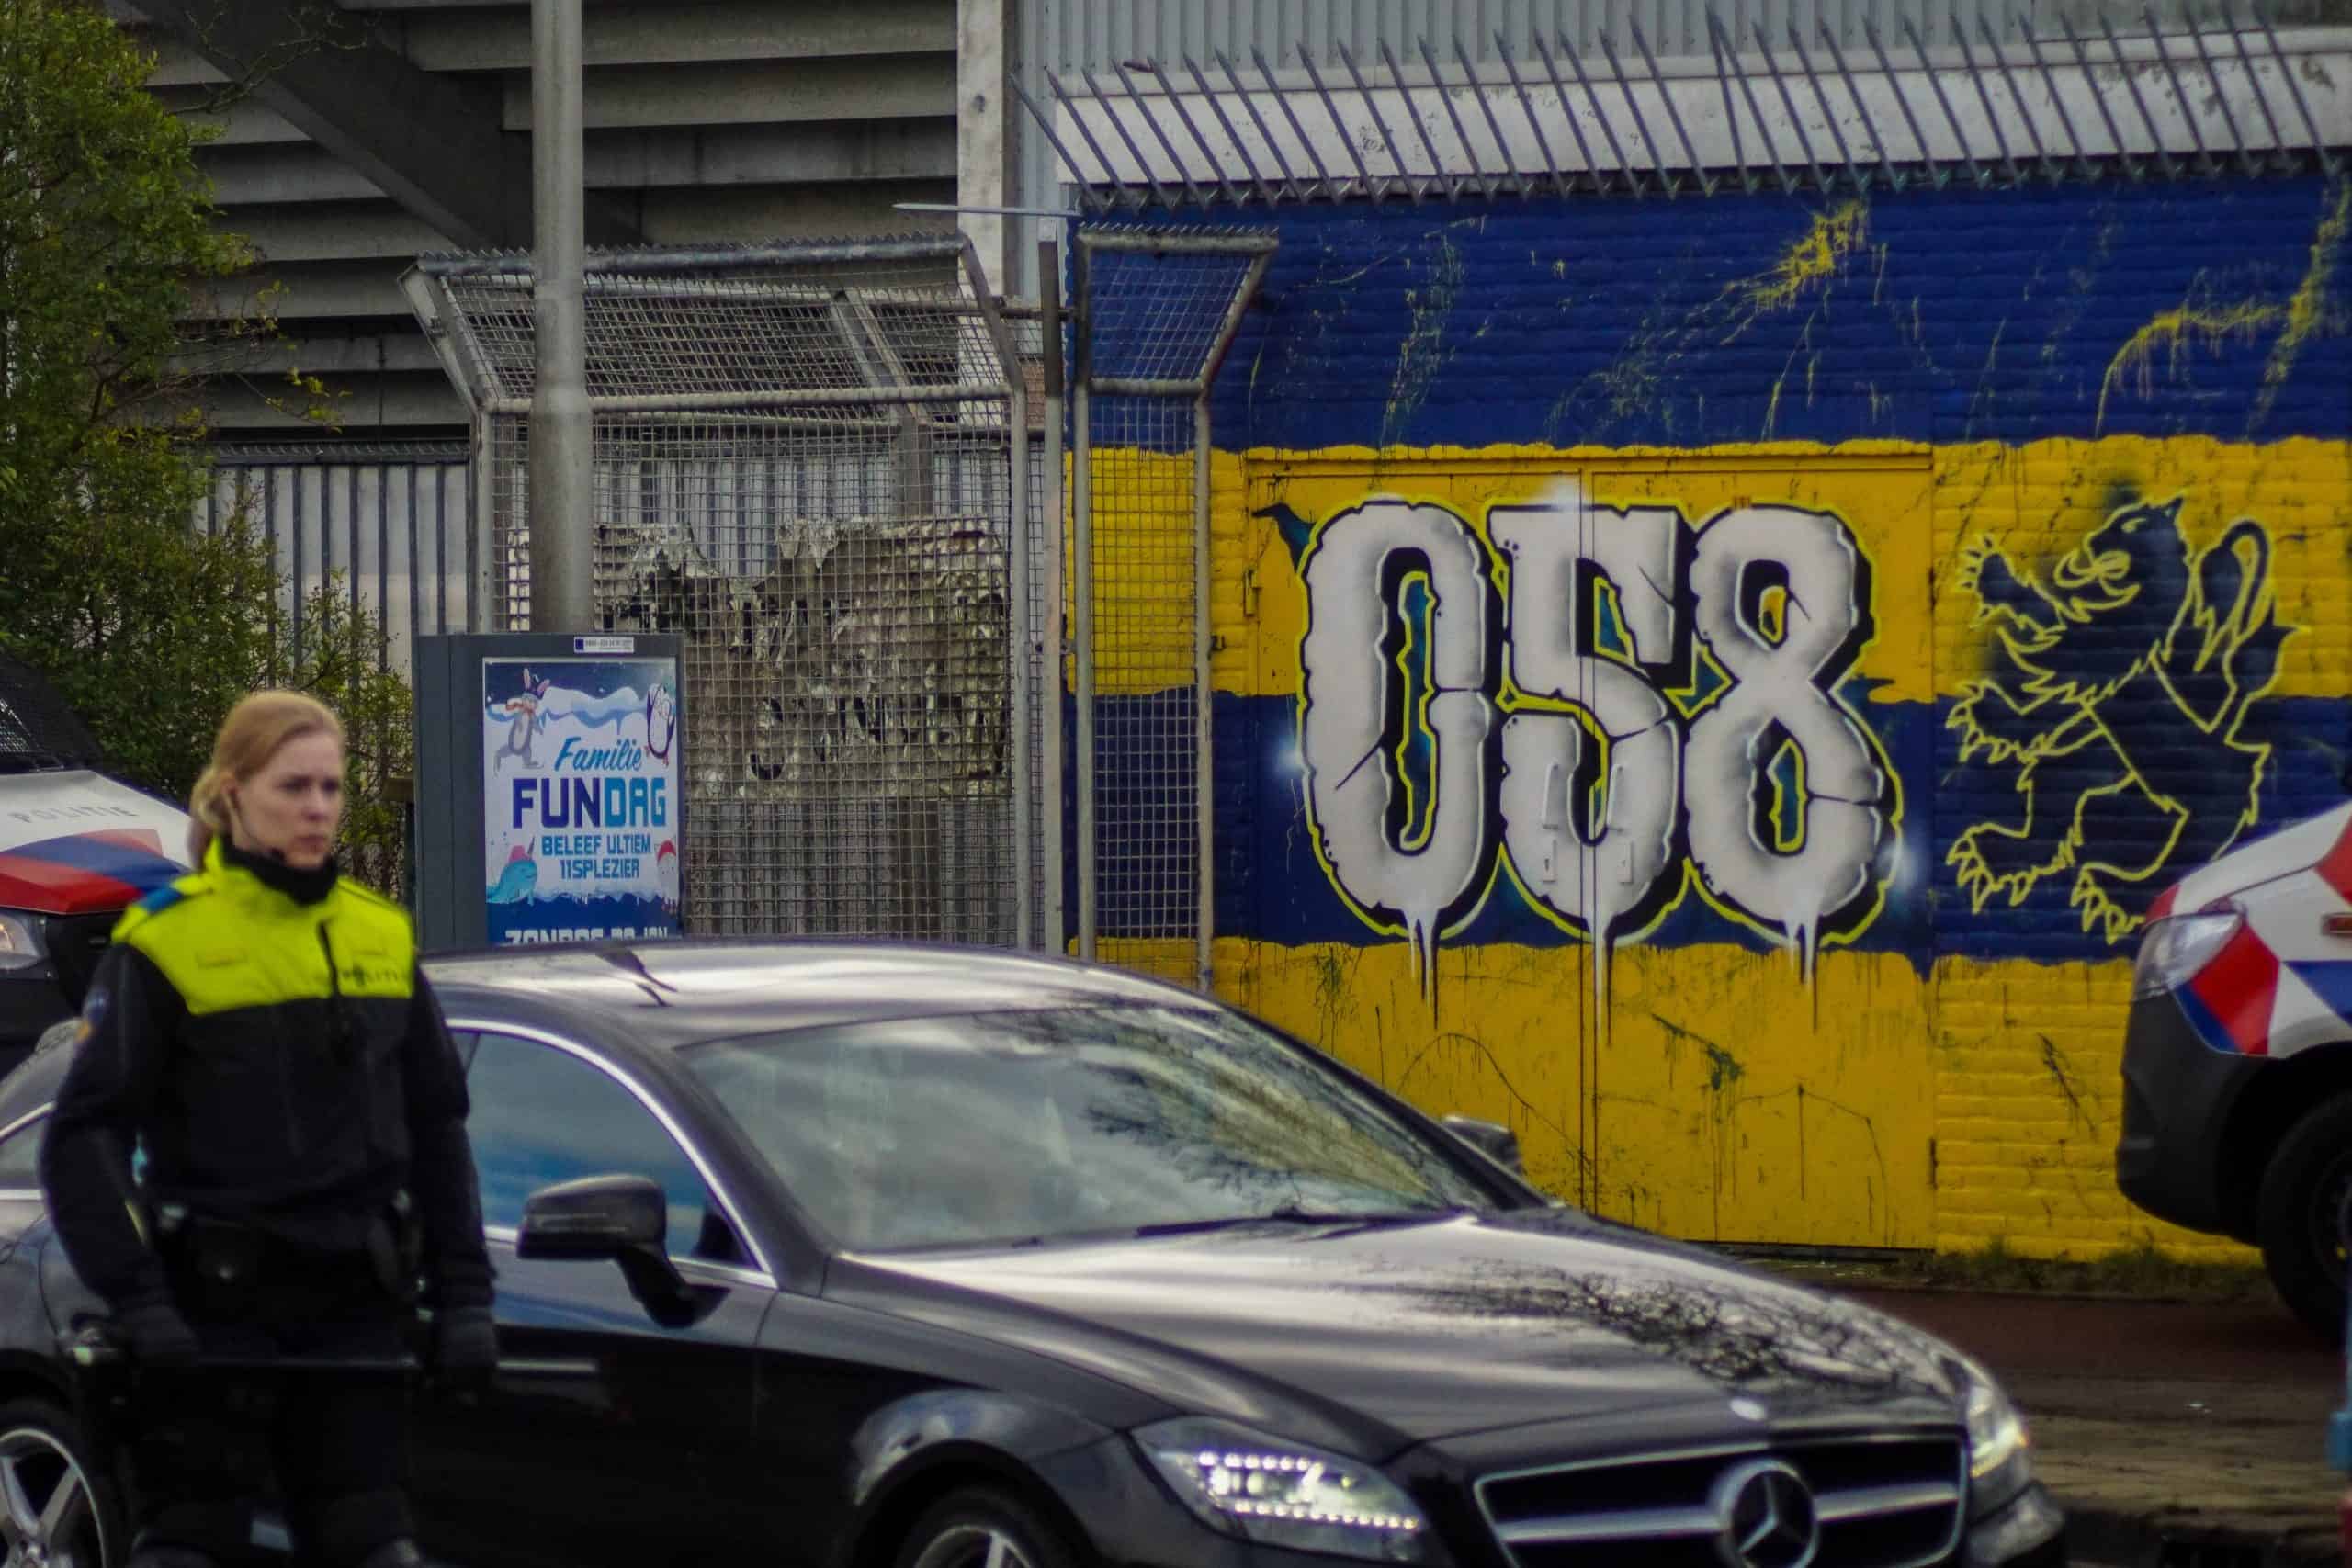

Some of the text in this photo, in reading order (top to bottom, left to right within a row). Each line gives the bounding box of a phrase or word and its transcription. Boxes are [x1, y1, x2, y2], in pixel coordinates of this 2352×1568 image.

[1297, 496, 1904, 948] 058
[554, 738, 642, 772] Familie
[513, 778, 666, 829] FUNDAG
[541, 833, 651, 855] BELEEF ULTIEM
